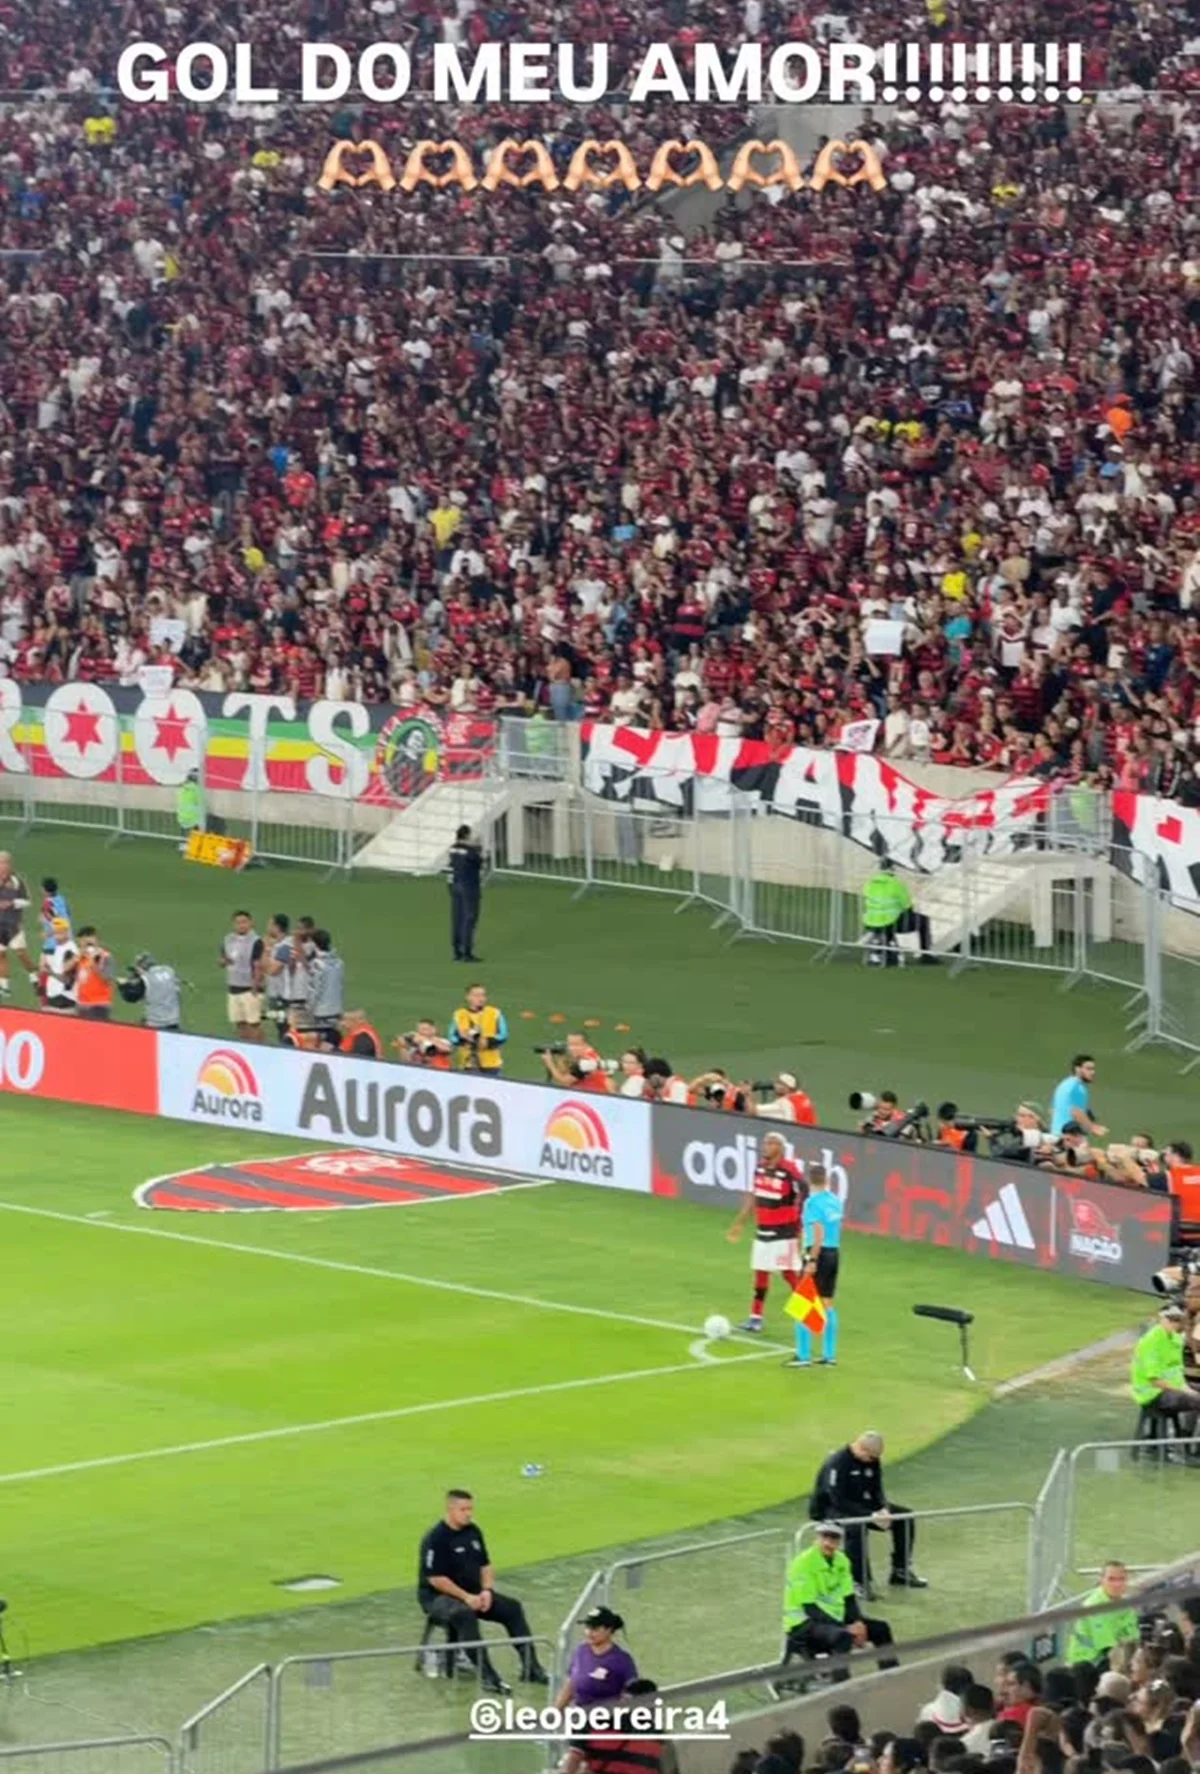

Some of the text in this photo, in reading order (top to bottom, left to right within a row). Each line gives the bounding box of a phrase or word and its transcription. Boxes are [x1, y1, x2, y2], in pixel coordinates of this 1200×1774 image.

[191, 1088, 263, 1122] Aurora
[298, 1062, 503, 1158] Aurora
[539, 1142, 614, 1177] Aurora
